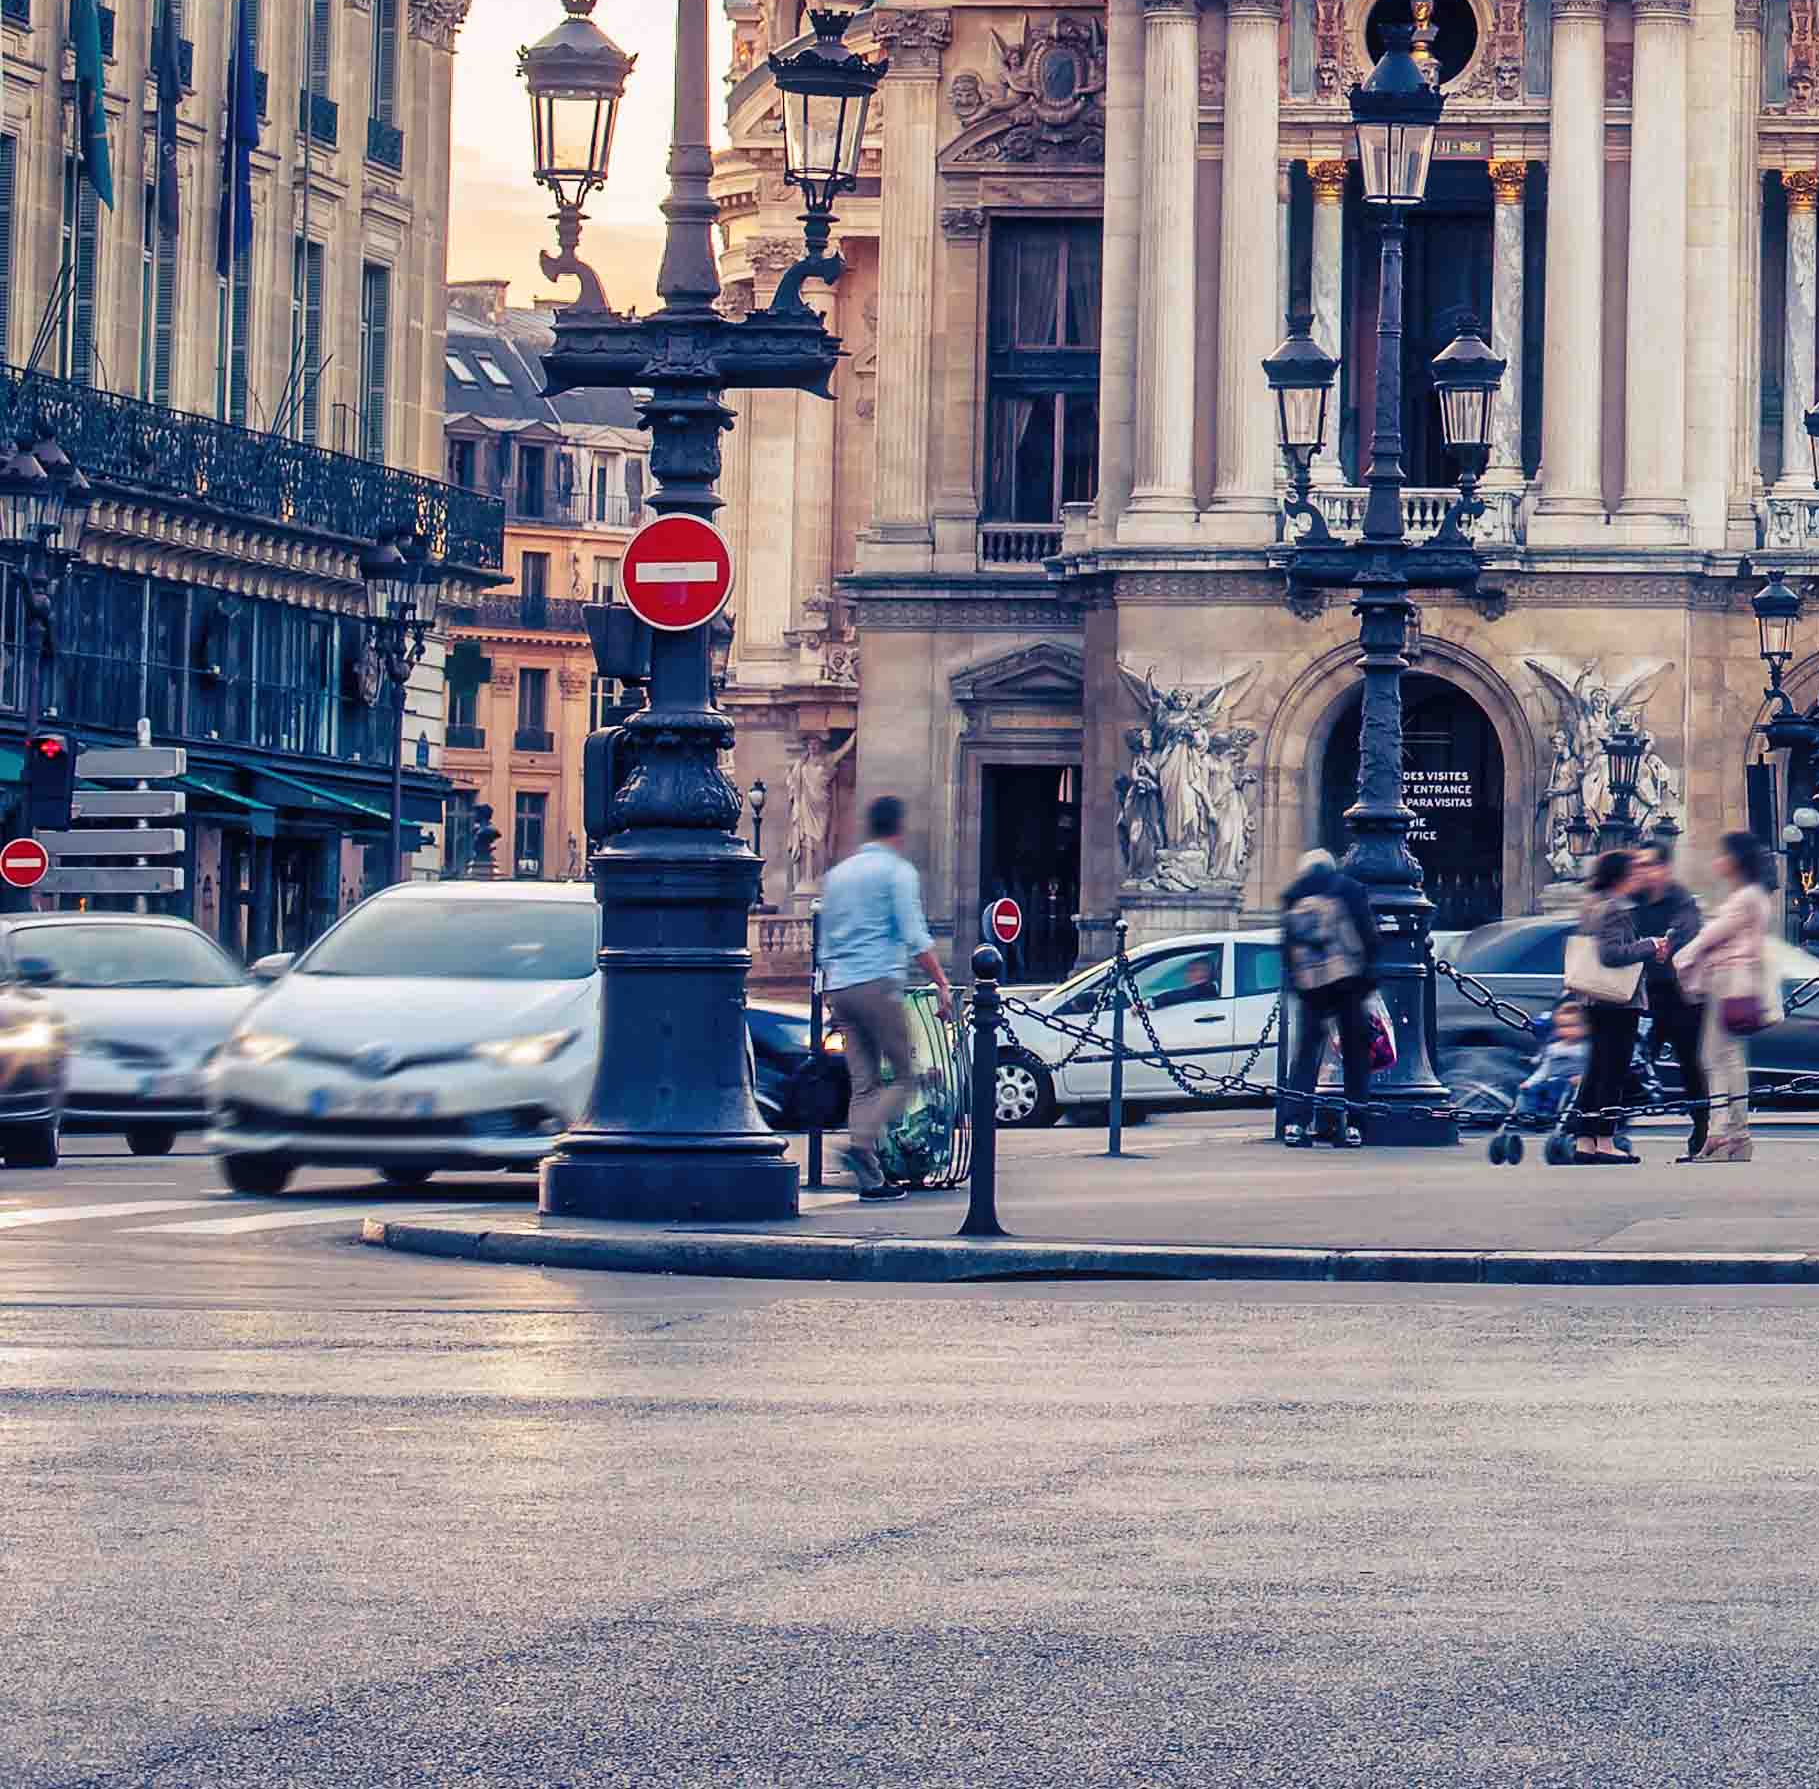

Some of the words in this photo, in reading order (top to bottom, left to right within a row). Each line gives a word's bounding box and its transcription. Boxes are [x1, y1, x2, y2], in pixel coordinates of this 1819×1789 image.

[1402, 771, 1425, 781] DES
[1426, 771, 1469, 781] VISITES
[1413, 785, 1472, 794] ENTRANCE
[1407, 798, 1434, 808] PARA
[1434, 798, 1472, 808] VISITAS
[1406, 831, 1438, 841] FFICE
